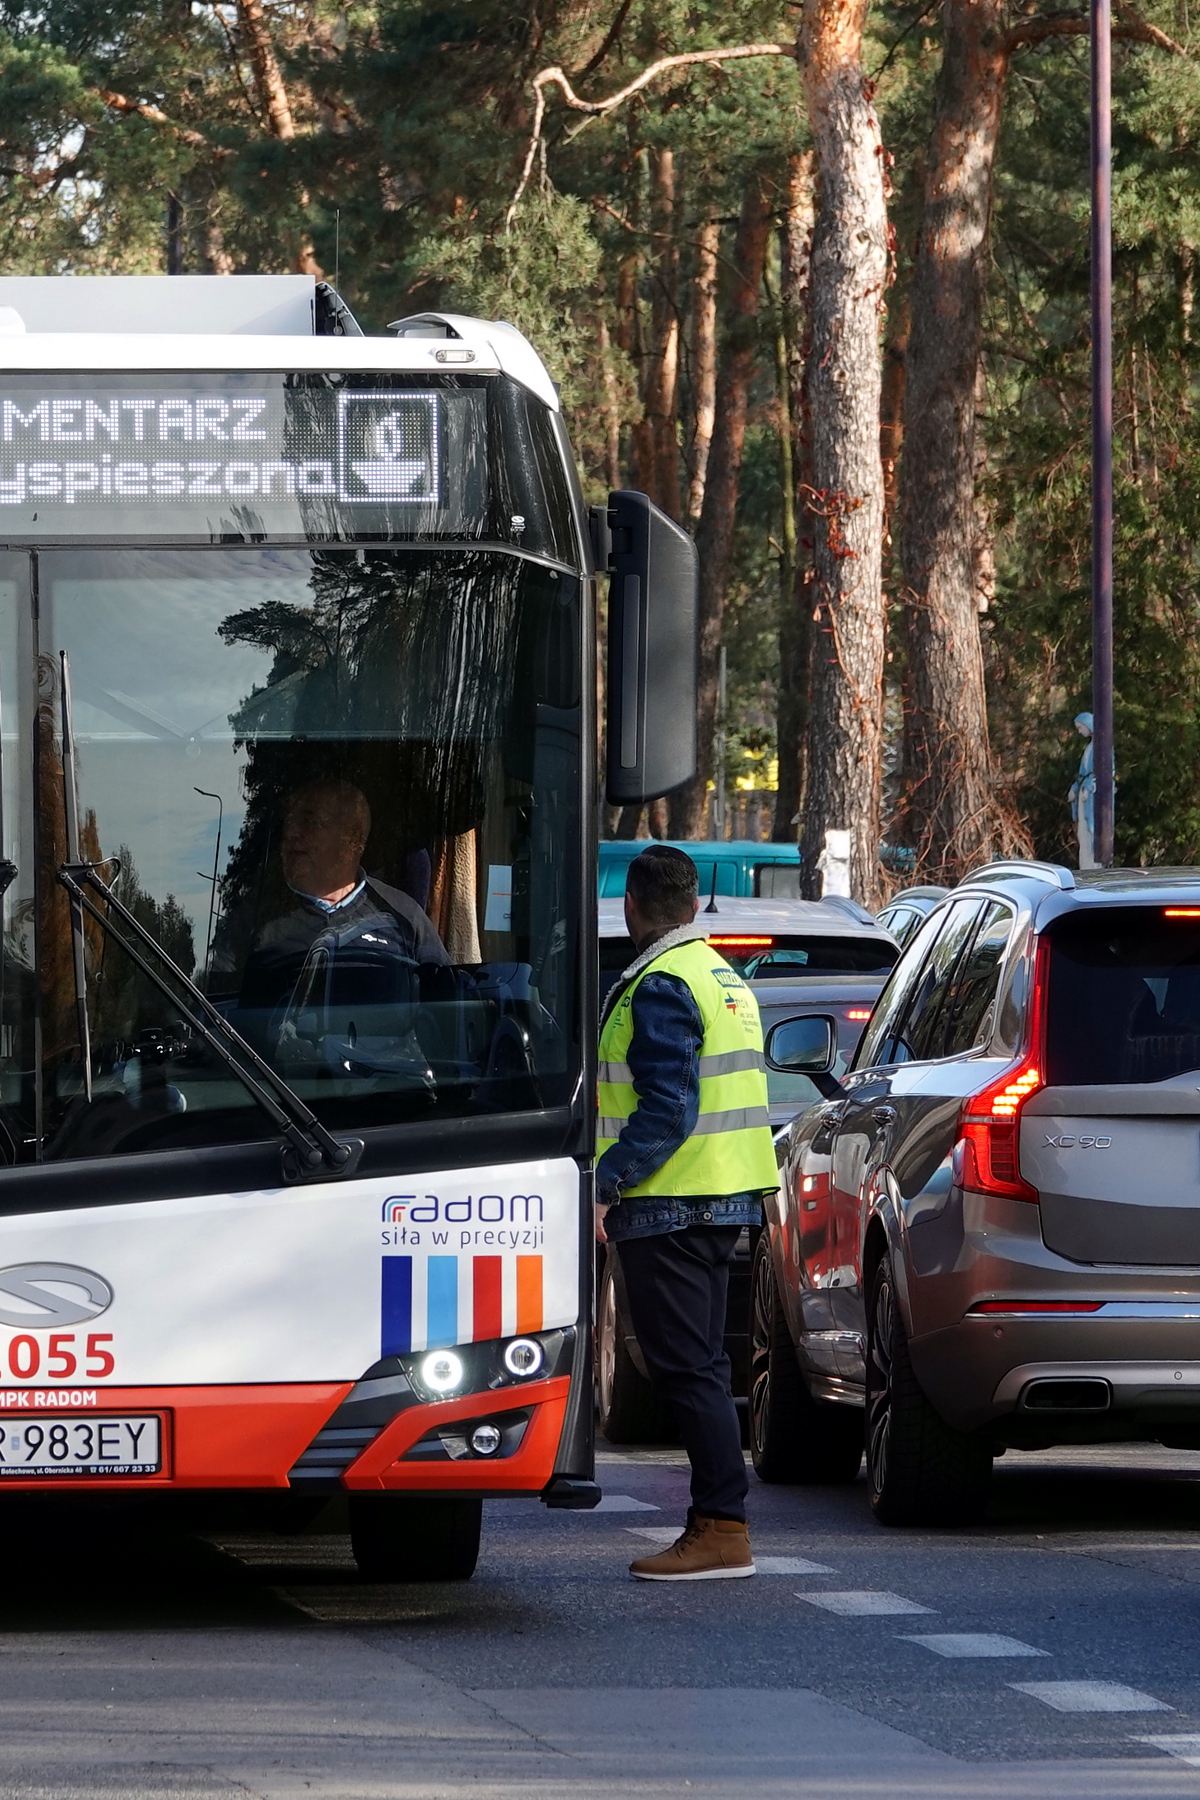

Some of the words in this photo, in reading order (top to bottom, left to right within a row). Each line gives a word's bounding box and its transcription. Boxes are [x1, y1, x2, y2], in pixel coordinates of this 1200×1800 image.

[381, 1195, 543, 1223] radom
[381, 1226, 421, 1246] siła
[431, 1231, 449, 1245] w
[460, 1226, 544, 1249] precyzji
[34, 1390, 97, 1407] RADOM
[24, 1422, 146, 1462] 983EY
[131, 1464, 143, 1473] 23
[144, 1464, 156, 1473] 33
